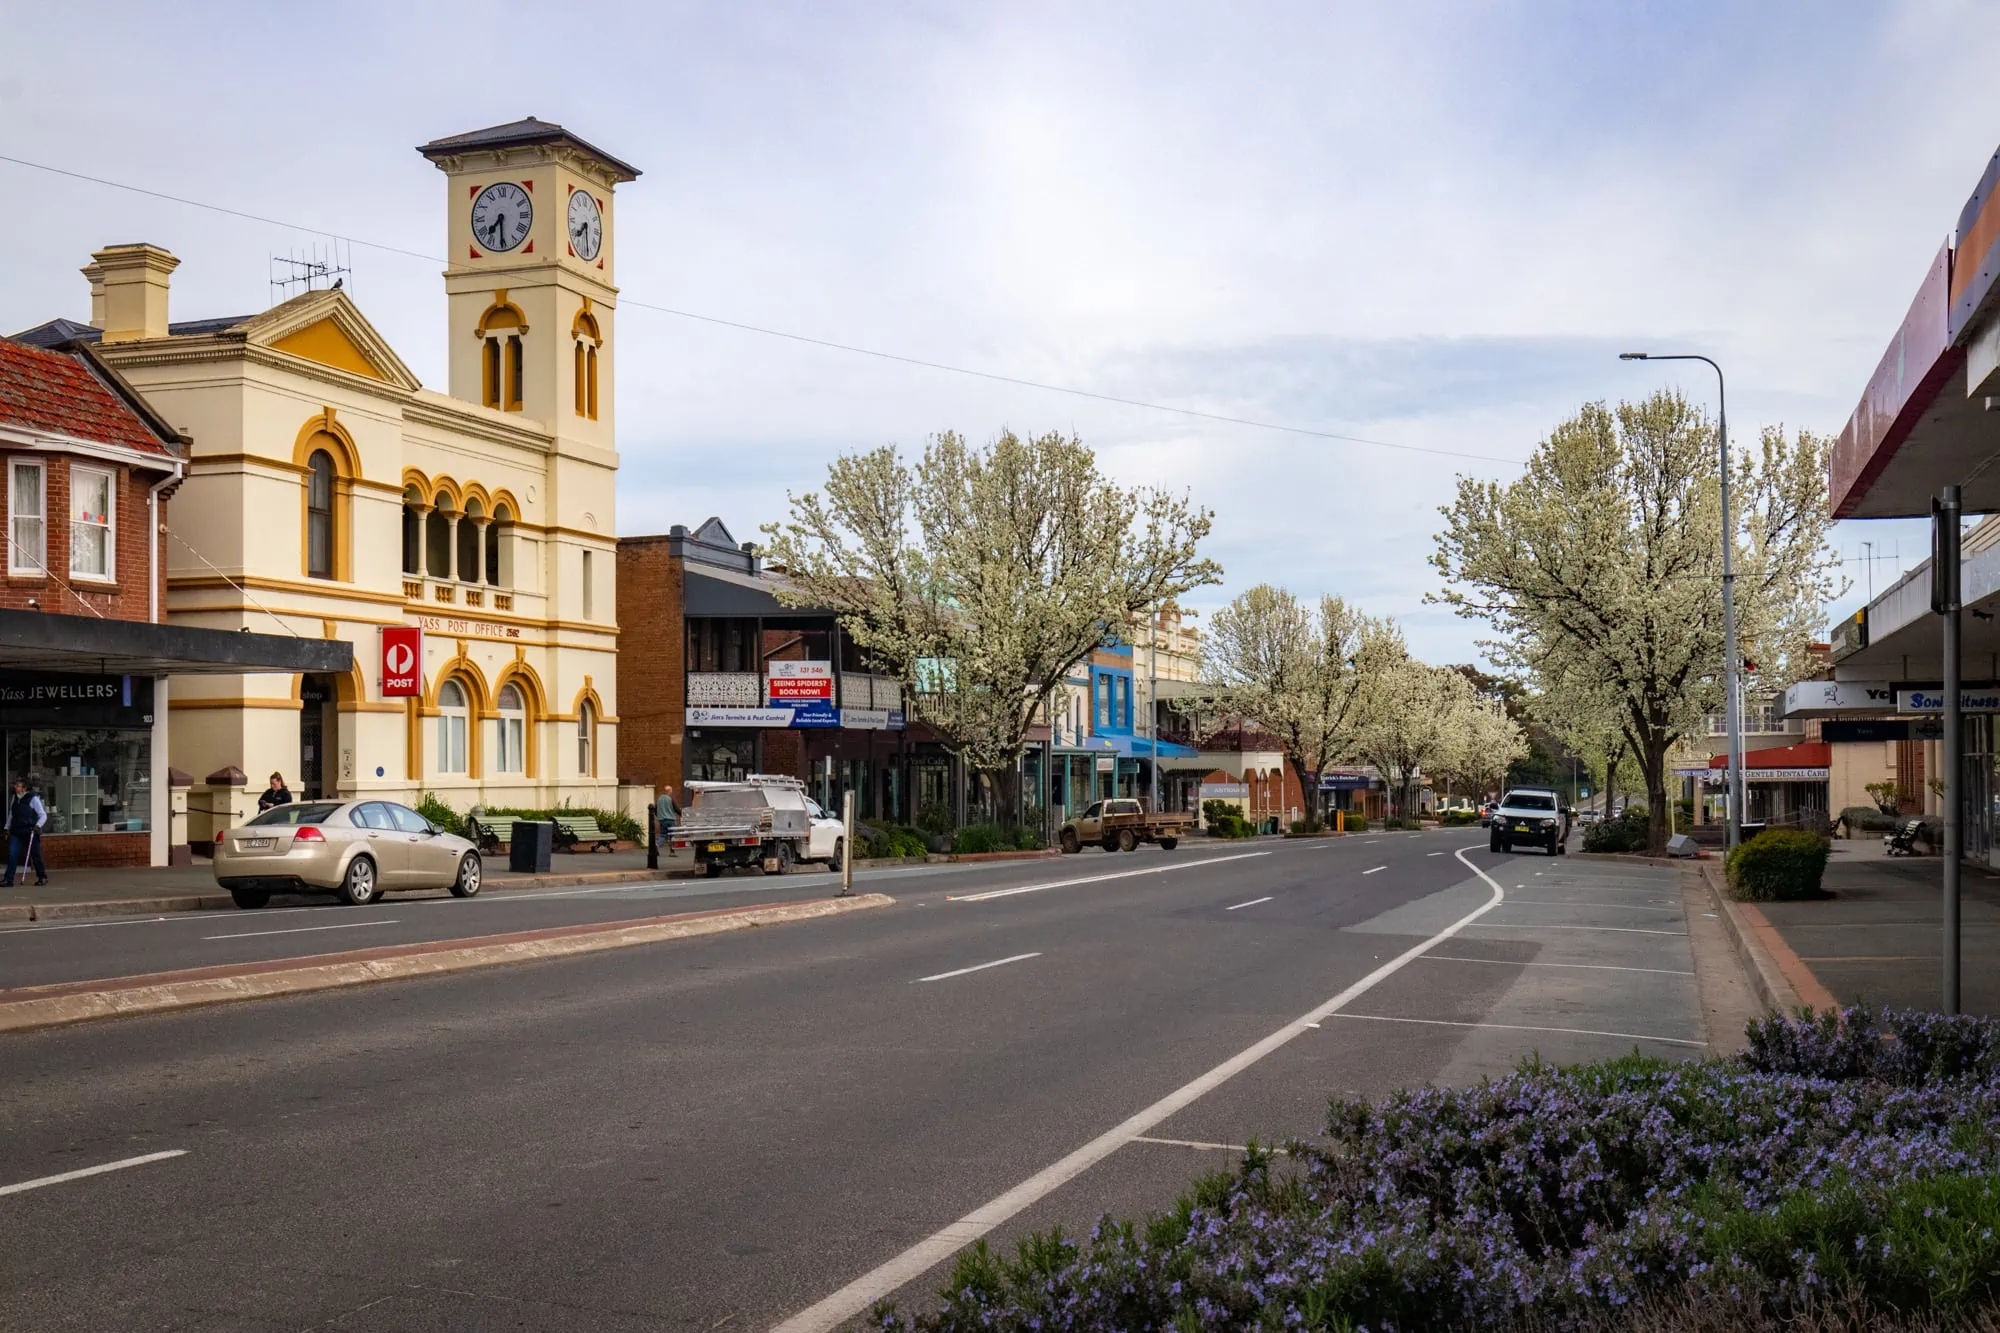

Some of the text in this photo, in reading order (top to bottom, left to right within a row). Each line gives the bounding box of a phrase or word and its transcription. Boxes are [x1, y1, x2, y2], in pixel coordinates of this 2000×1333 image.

[418, 616, 440, 631] YASS
[447, 619, 469, 634] POST
[474, 623, 504, 638] OFFICE
[387, 678, 414, 688] POST
[0, 684, 114, 701] Yass JEWELLERS
[1910, 692, 1998, 708] Soni itness
[1745, 770, 1774, 778] GENTLE
[1776, 770, 1806, 778] DENTAL
[1807, 769, 1827, 777] CARE
